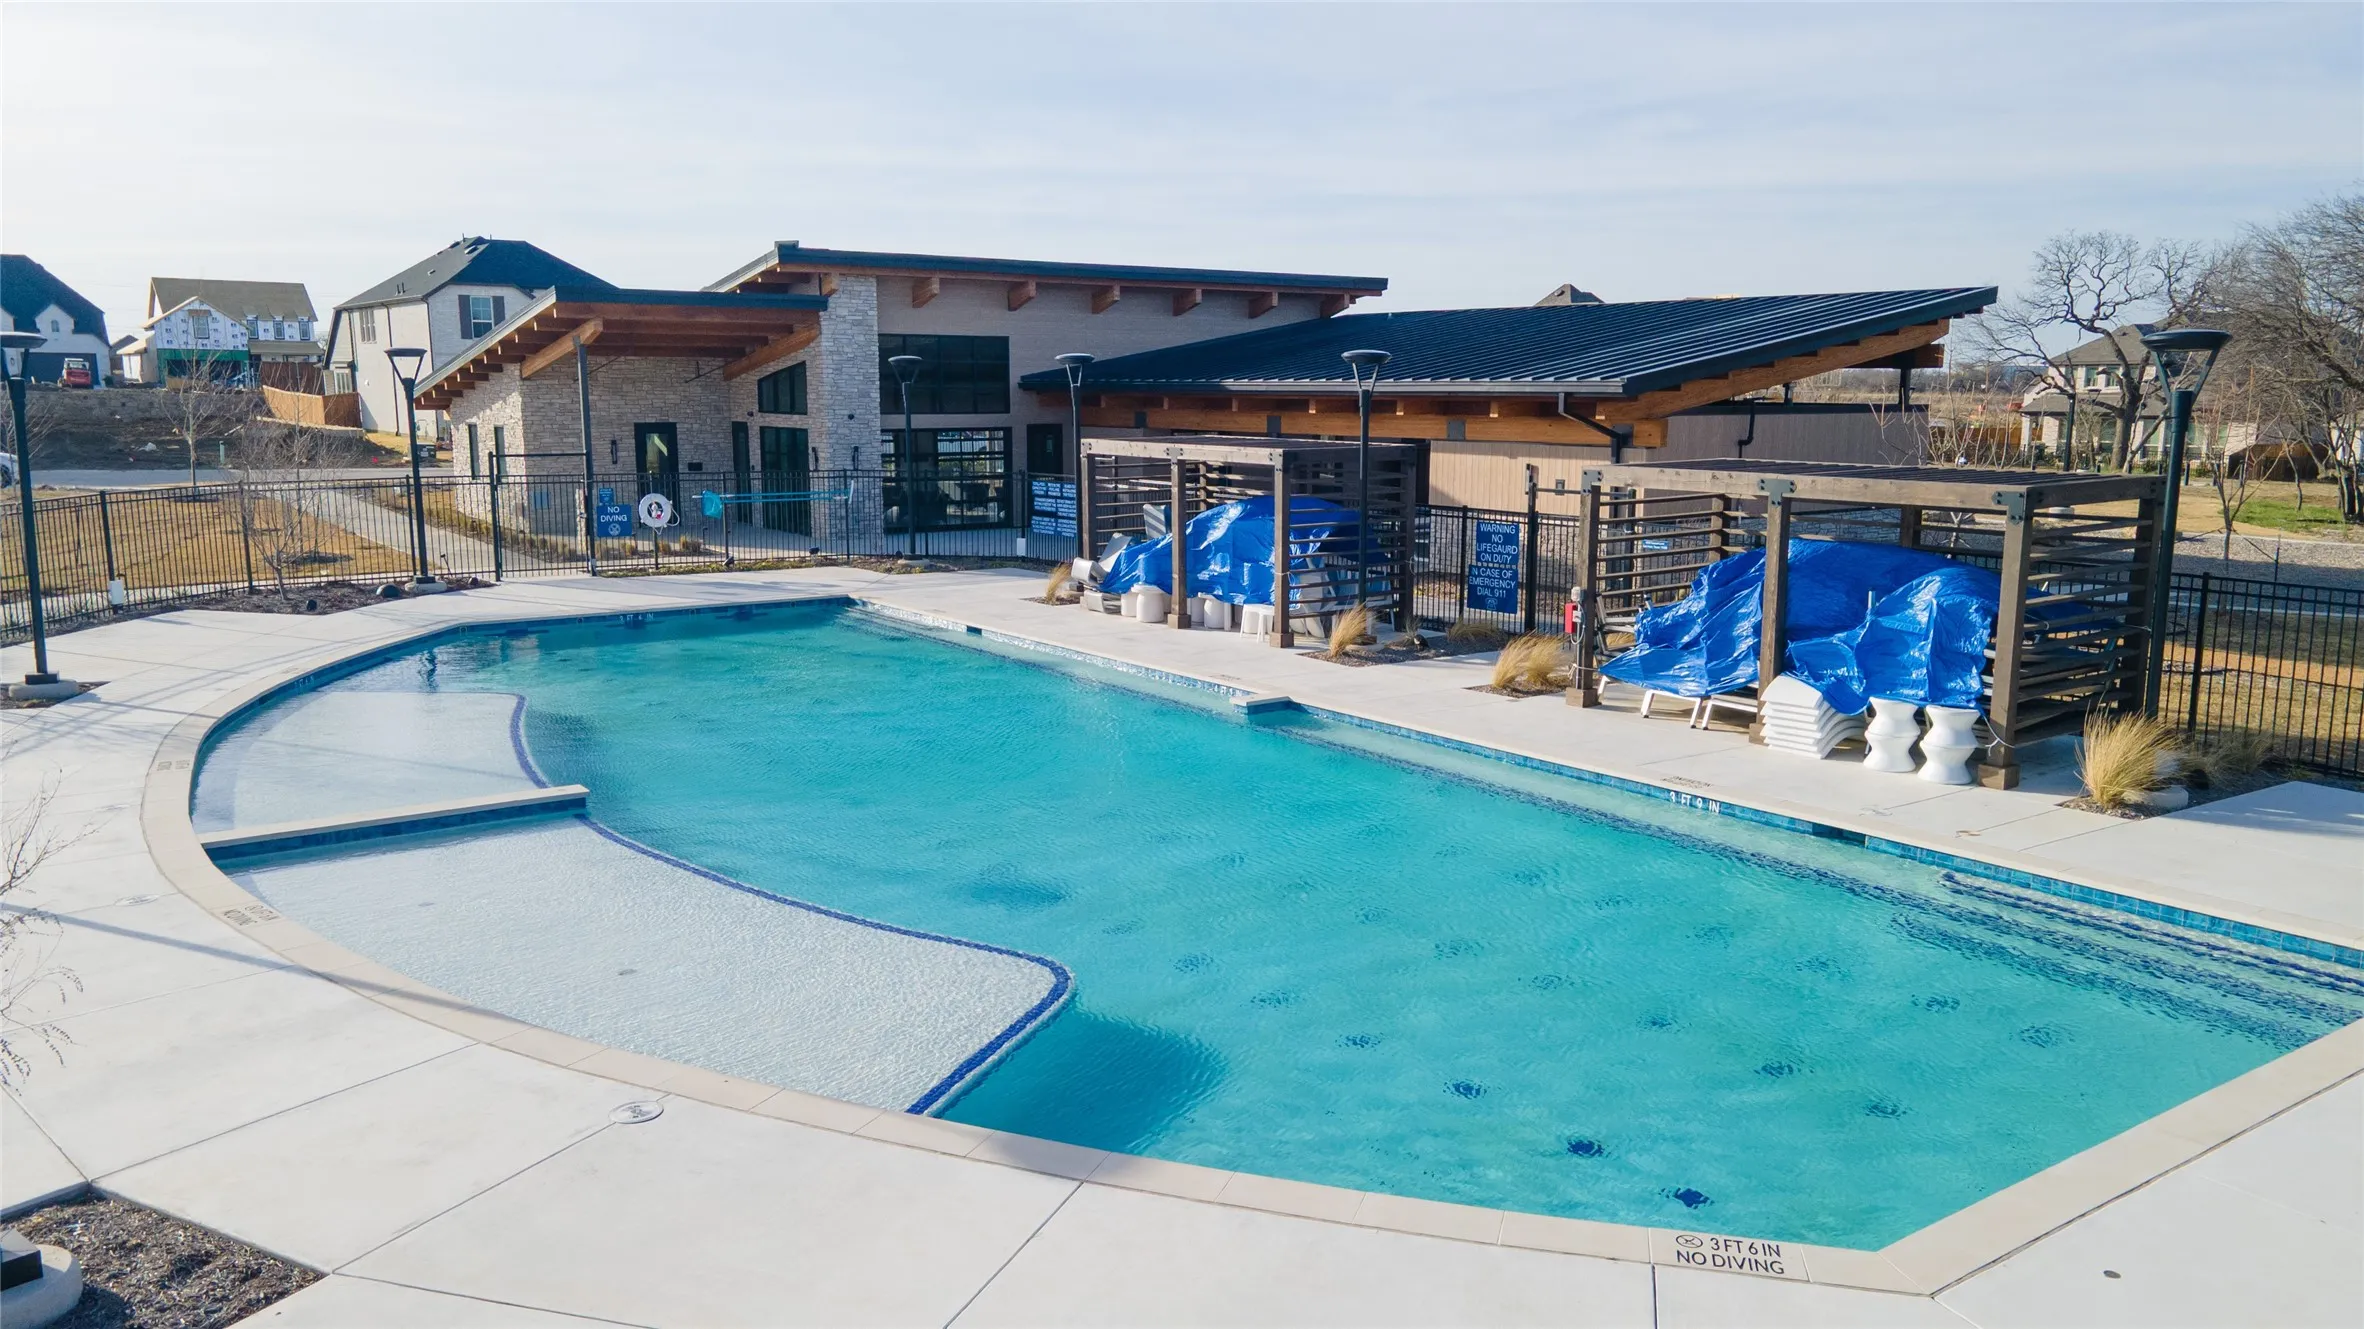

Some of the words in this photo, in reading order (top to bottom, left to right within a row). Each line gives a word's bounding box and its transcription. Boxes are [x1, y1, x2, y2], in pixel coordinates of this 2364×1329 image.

[607, 506, 620, 514] NO
[600, 514, 628, 523] DIVING
[1480, 523, 1516, 534] WARNING
[1491, 534, 1504, 543] NO
[1476, 543, 1518, 555] LIFEGAURD
[1480, 552, 1492, 562] ON
[1493, 553, 1512, 564] DUTY
[1480, 567, 1500, 578] CASE
[1501, 569, 1513, 579] OF
[1468, 576, 1516, 589] EMERGENCY
[1476, 586, 1493, 597] DIAL
[1494, 588, 1506, 598] 911
[1681, 793, 1692, 807] FT
[1708, 799, 1720, 813] IN
[1710, 1237, 1720, 1251] 3
[1723, 1238, 1743, 1254] FT
[1748, 1241, 1758, 1256] 6
[1762, 1243, 1781, 1258] IN
[1676, 1249, 1707, 1266] NO
[1712, 1253, 1785, 1275] DIVING
